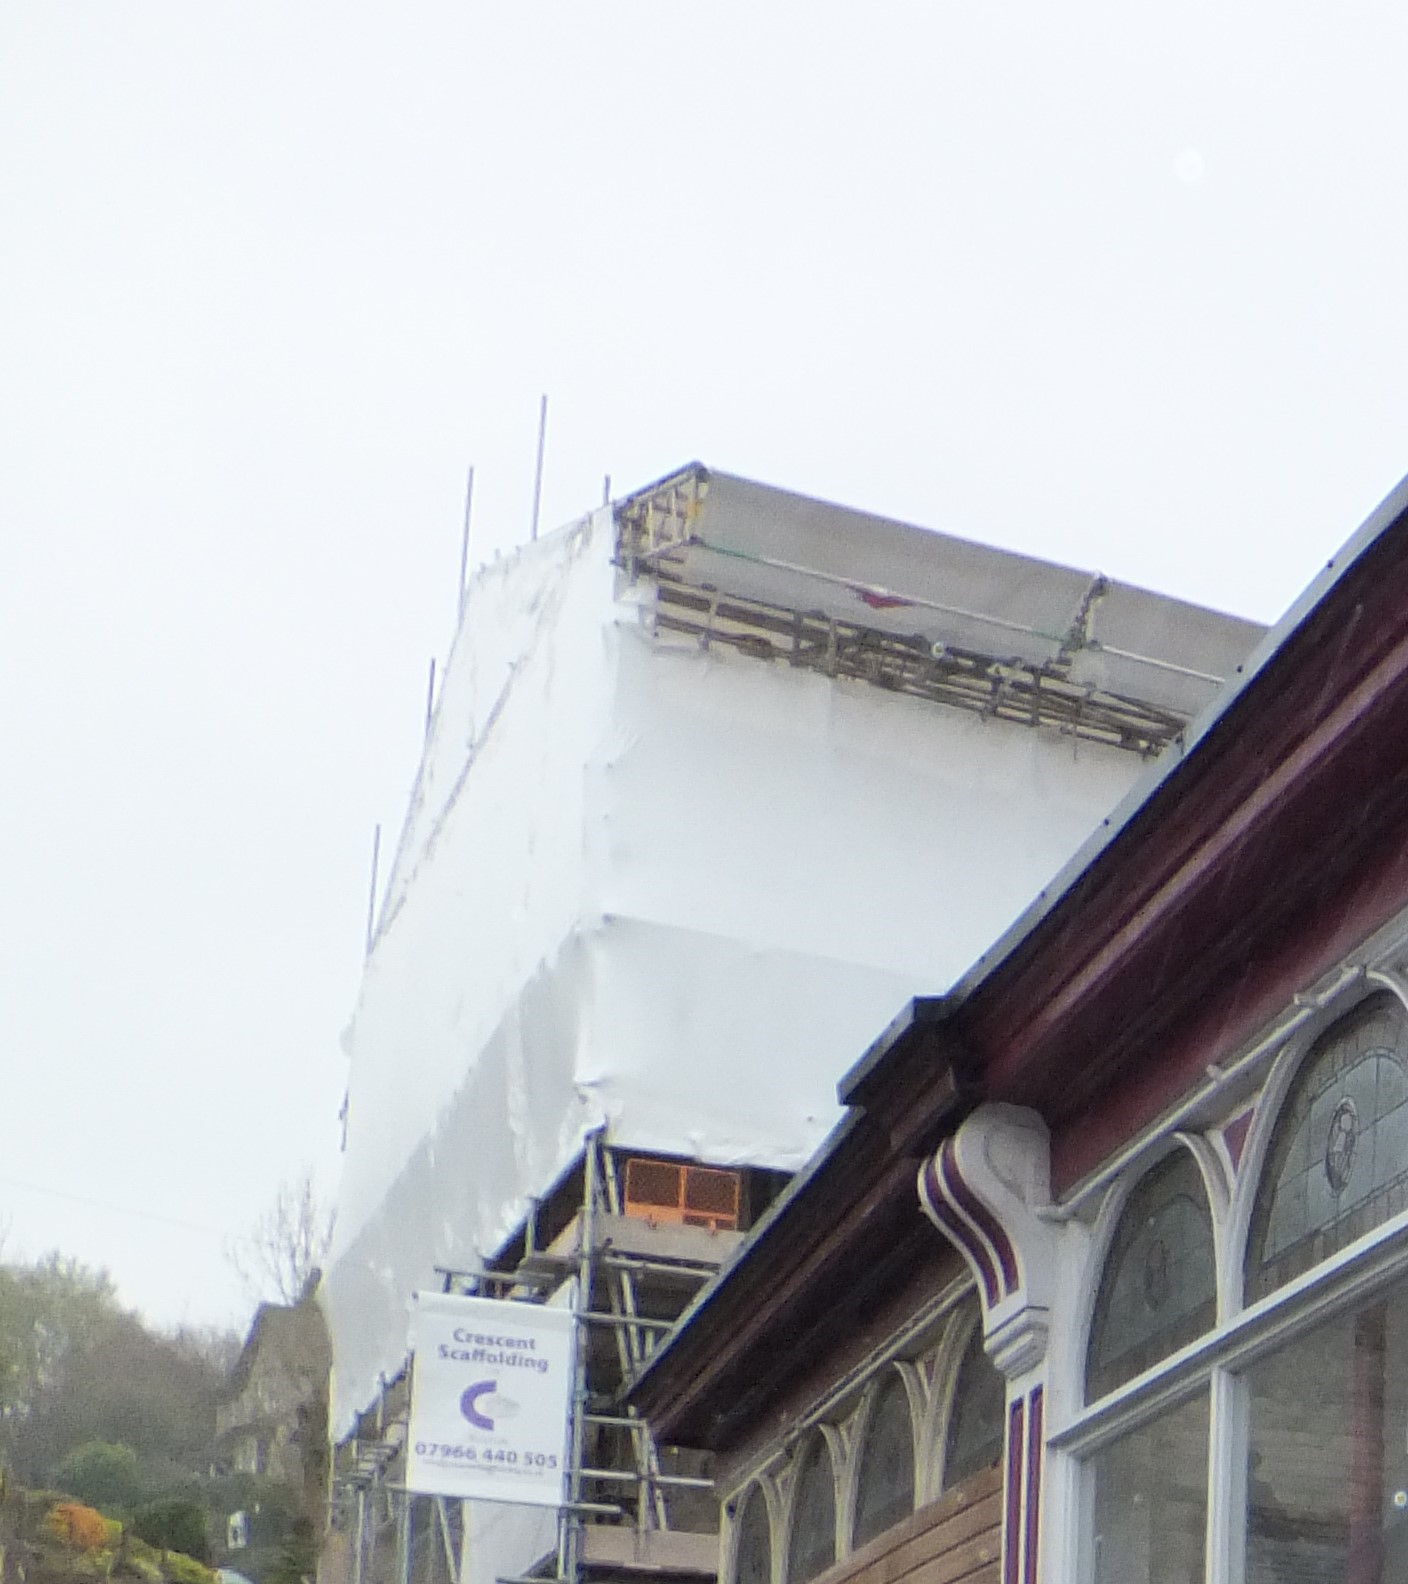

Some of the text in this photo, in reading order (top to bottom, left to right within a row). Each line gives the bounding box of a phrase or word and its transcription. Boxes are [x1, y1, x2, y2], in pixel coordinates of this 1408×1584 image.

[453, 1328, 536, 1351] Crescent
[437, 1344, 549, 1373] Scaffolding
[483, 1449, 518, 1464] 440
